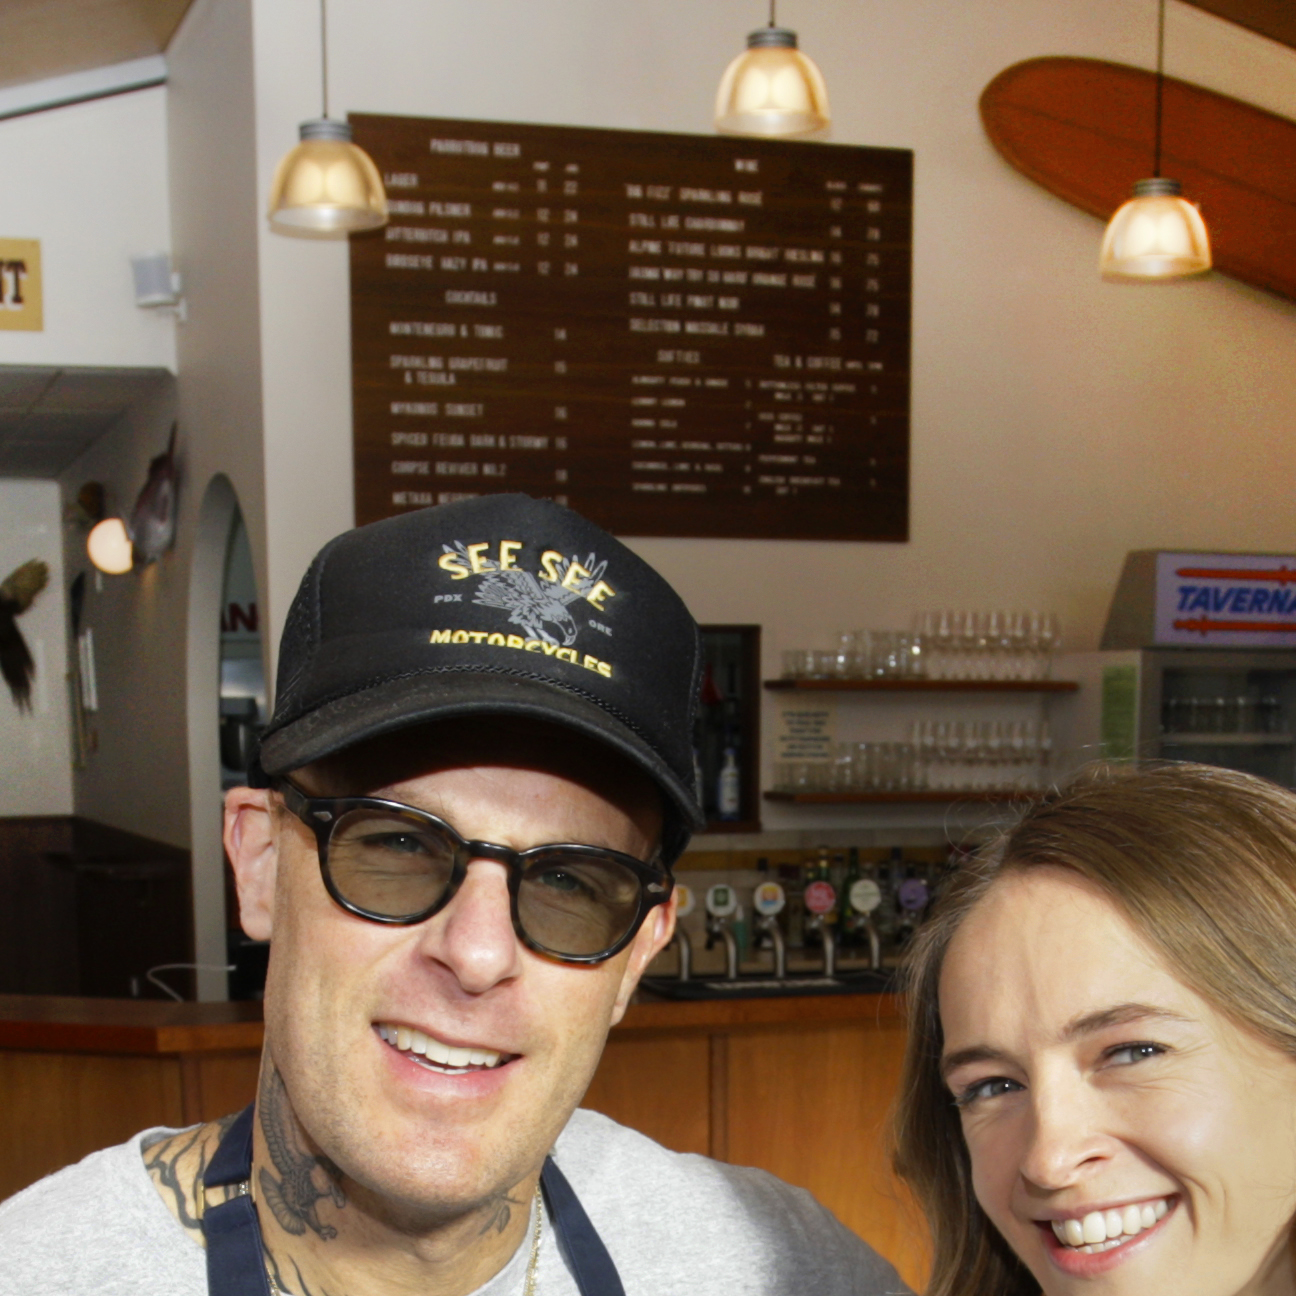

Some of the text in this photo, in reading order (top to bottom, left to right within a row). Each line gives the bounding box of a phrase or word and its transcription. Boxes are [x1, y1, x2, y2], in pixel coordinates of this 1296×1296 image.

[493, 142, 522, 158] BEER
[735, 158, 759, 172] WINE
[385, 172, 419, 188] LAGER
[429, 201, 472, 217] PILSNER
[445, 290, 498, 306] COCKTAILS
[389, 321, 457, 337] MONTENEGRO
[474, 325, 504, 339] TONIC
[389, 354, 444, 370] SPARKLING
[448, 356, 509, 372] GRAPEFRUIT
[445, 402, 484, 417] SUNSET
[391, 431, 429, 446] SPICED
[470, 433, 496, 448] DARK
[509, 435, 550, 449] STORMY
[391, 460, 430, 475] CORPSE
[435, 461, 478, 475] REVIVER
[438, 540, 616, 612] SEE SEE
[434, 593, 463, 604] PDX
[588, 619, 613, 637] ORE
[429, 629, 613, 678] MOTORCYCLES
